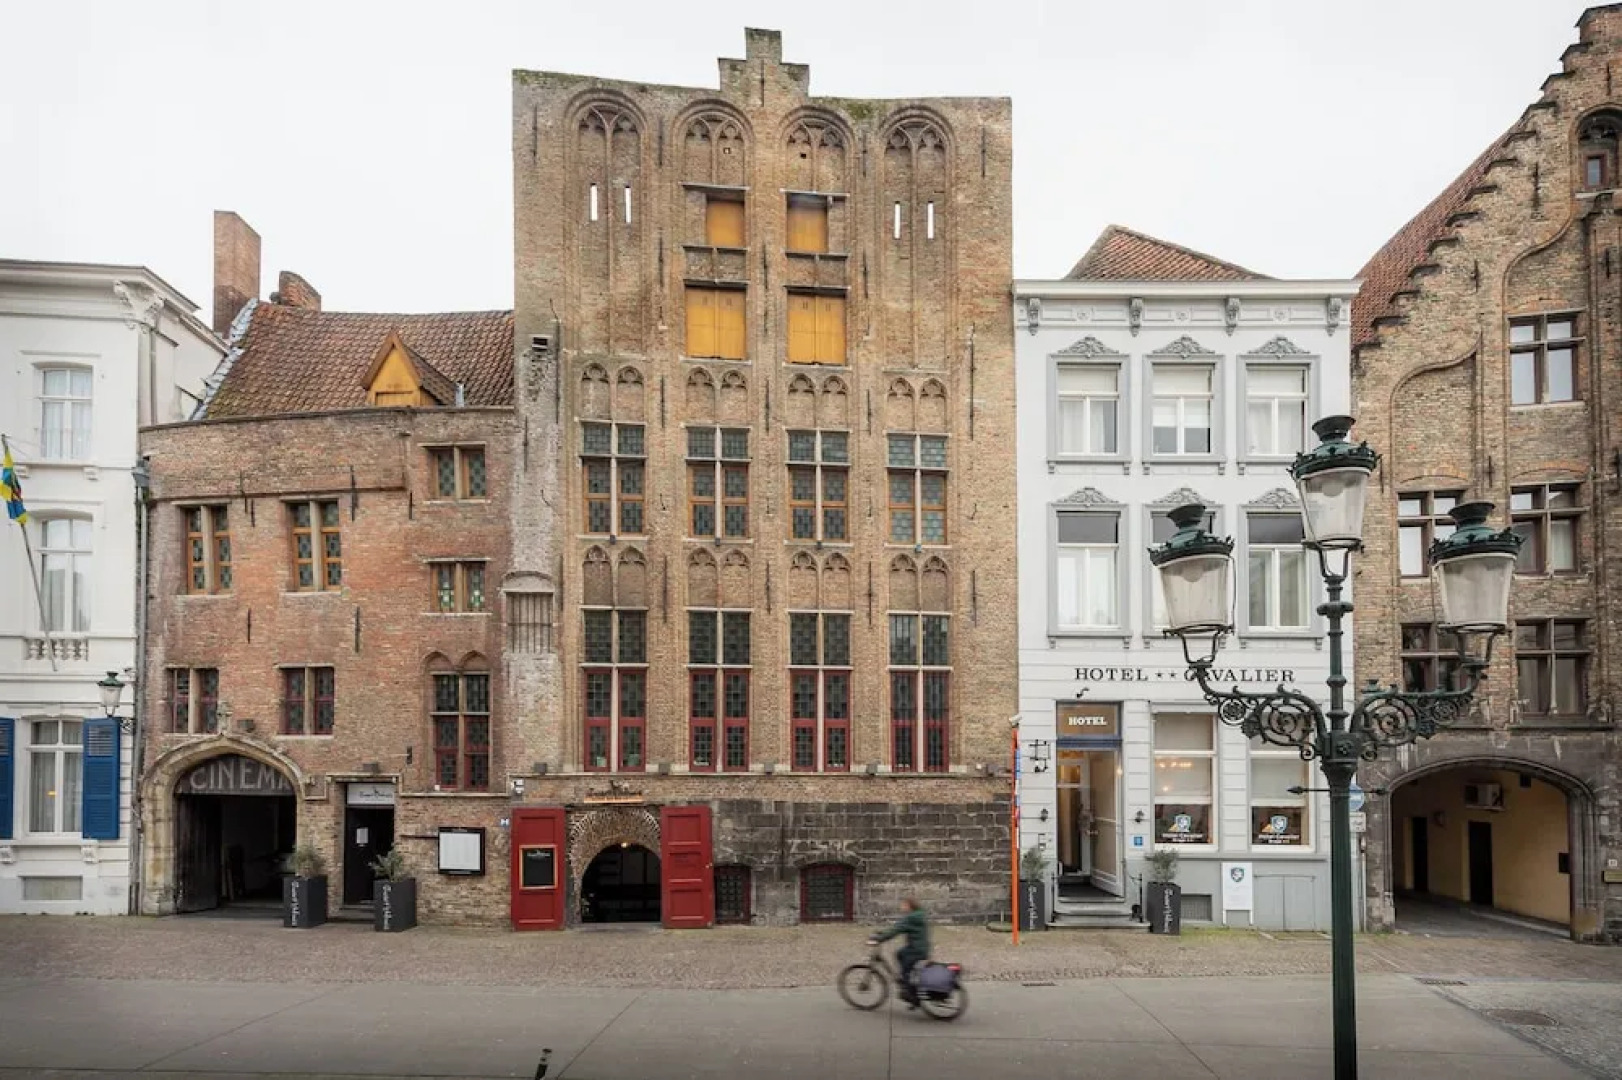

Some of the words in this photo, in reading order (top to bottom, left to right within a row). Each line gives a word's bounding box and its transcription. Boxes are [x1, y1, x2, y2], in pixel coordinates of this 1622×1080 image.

[1074, 667, 1148, 681] HOTEL
[1184, 669, 1294, 682] CVALIER
[1068, 716, 1107, 726] HOTEL
